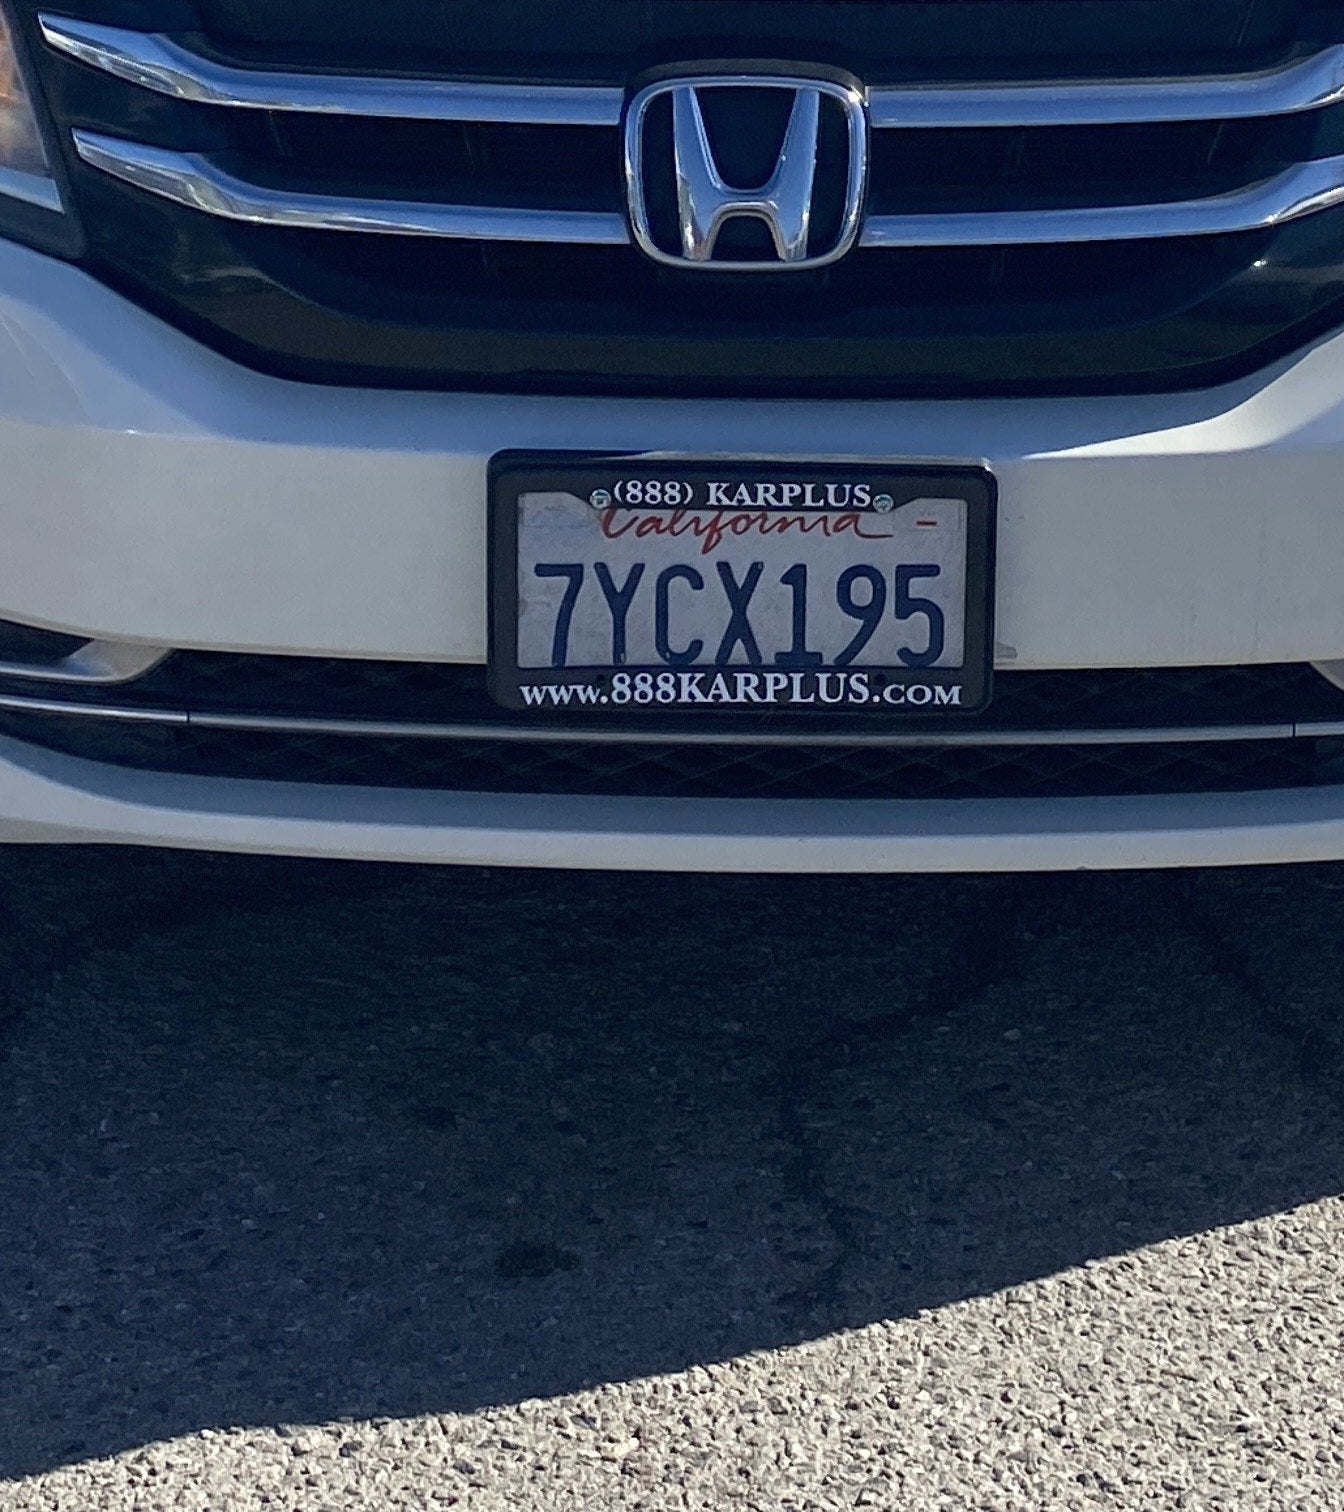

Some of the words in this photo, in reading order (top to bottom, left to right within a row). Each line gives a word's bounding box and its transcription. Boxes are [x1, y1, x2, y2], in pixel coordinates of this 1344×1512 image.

[613, 479, 694, 506] (888)
[706, 482, 872, 507] KARPLUS
[600, 508, 894, 555] California
[533, 561, 946, 668] 7YCX195
